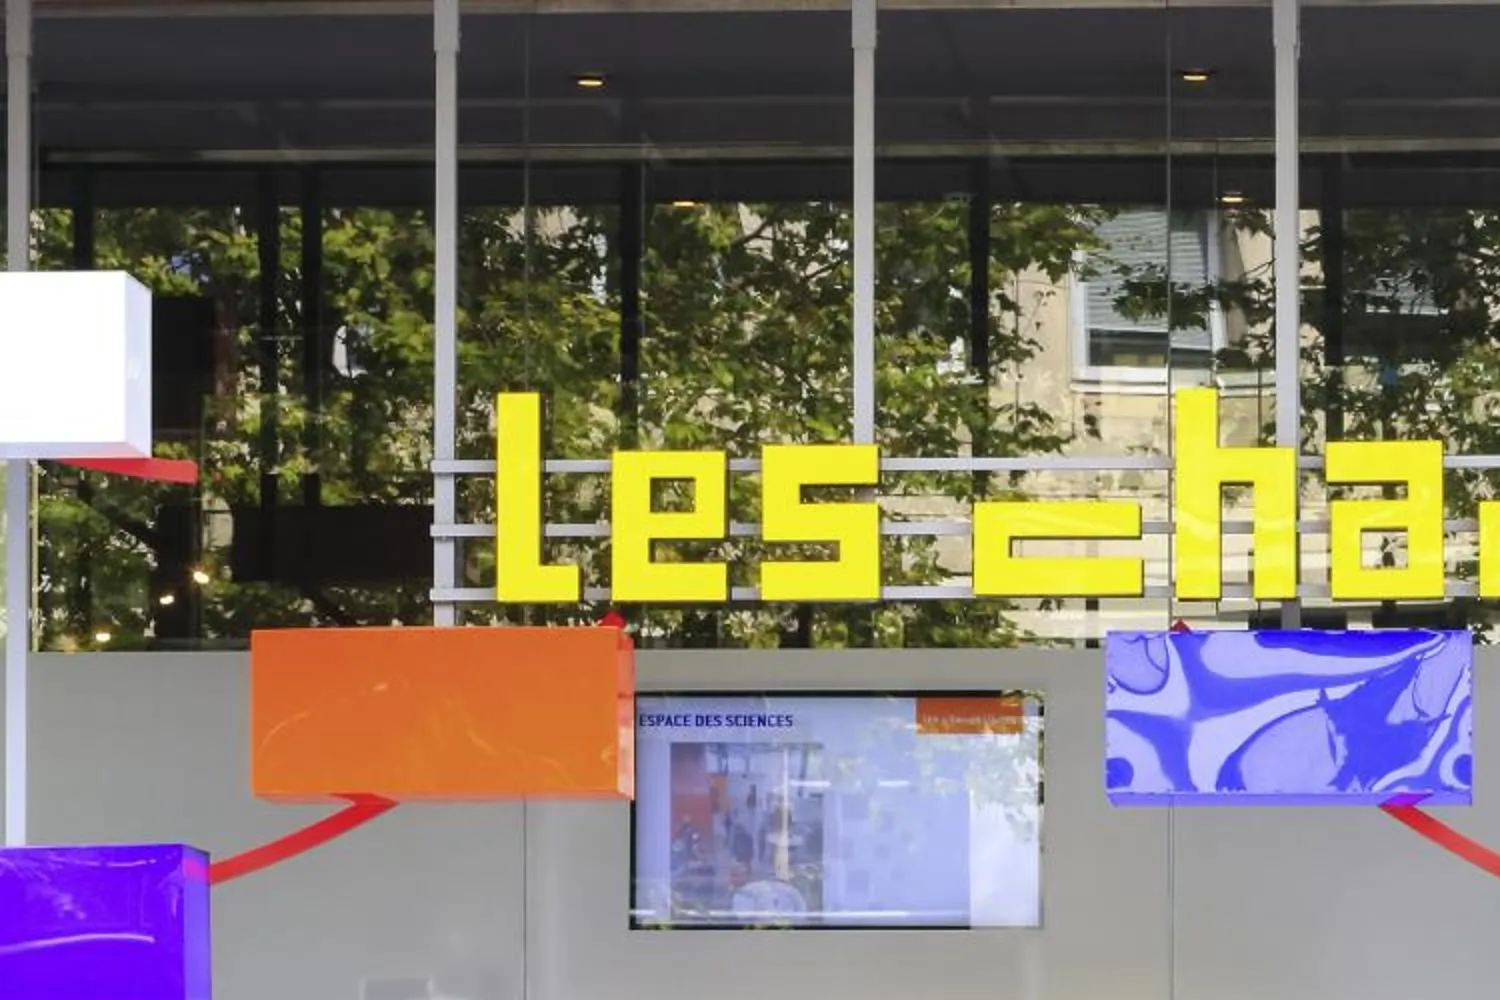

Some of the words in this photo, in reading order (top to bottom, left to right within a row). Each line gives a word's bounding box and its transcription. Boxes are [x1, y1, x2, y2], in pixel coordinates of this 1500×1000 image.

[639, 713, 691, 728] ESPACE
[695, 713, 722, 728] DES
[725, 713, 794, 728] SCIENCES
